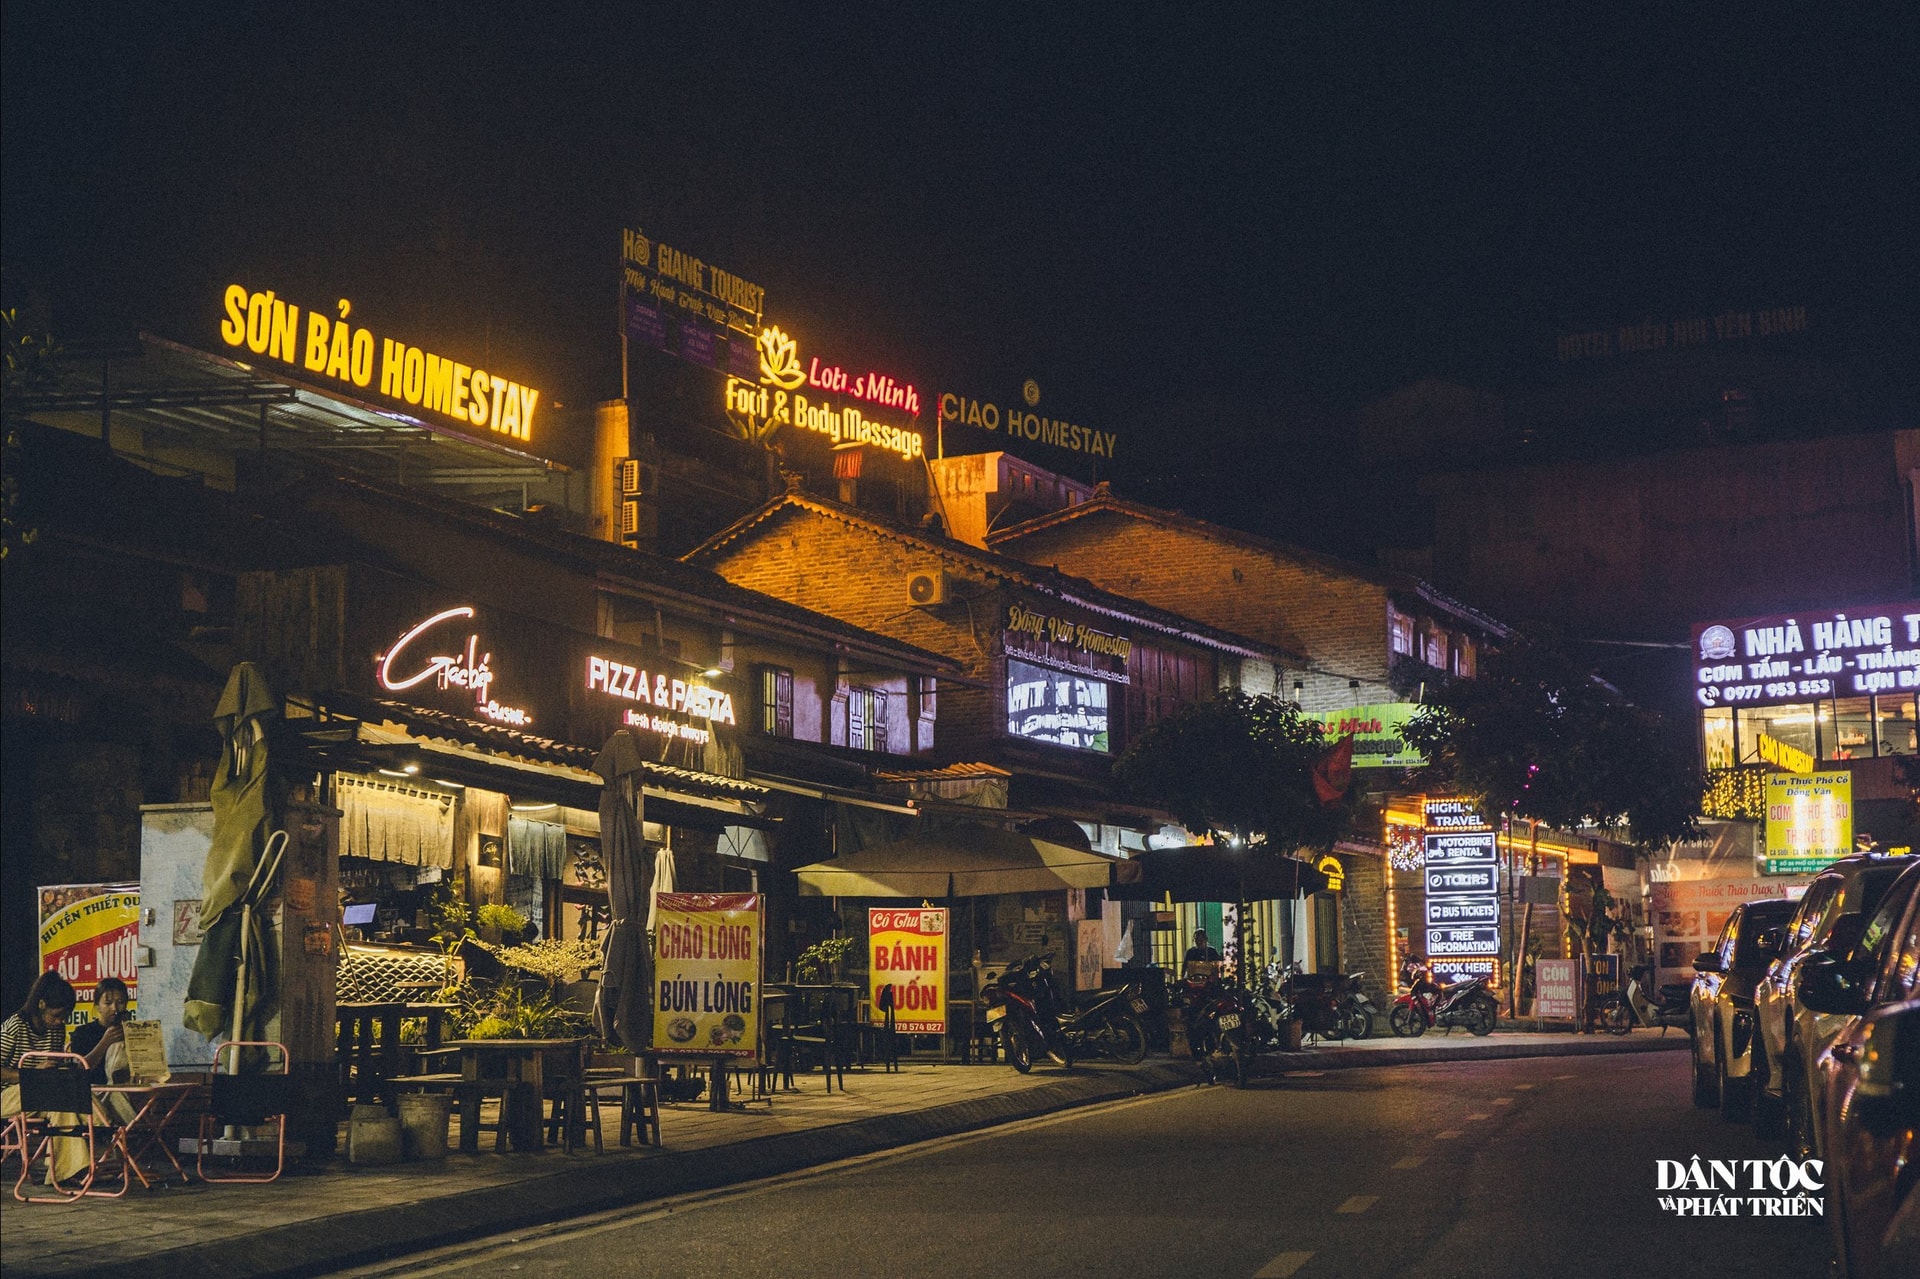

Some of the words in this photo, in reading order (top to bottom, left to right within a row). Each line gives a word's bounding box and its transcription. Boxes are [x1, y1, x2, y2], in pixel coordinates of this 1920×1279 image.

[658, 243, 702, 289] GIANG
[710, 265, 765, 314] TOURIST
[221, 284, 299, 364] SƠN
[304, 299, 375, 387] BẢO
[380, 337, 539, 442] HOMESTAY
[866, 372, 921, 413] Minh
[794, 394, 840, 443] Body
[842, 407, 922, 461] Massage
[942, 393, 1000, 431] CIAO
[1008, 409, 1117, 459] HOMESTAY
[1076, 624, 1132, 665] Homestay
[1744, 619, 1804, 657] NHÀ
[1812, 613, 1892, 651] HÀNG
[1698, 664, 1742, 683] CƠM
[1749, 655, 1790, 680] TẤM
[1804, 650, 1843, 675] LẨU
[589, 656, 651, 703] PIZZA
[654, 674, 669, 708] &
[671, 678, 736, 726] PASTA
[1723, 685, 1763, 701] 0977
[1765, 682, 1797, 698] 953
[1799, 679, 1830, 695] 553
[1854, 672, 1895, 693] LỢN
[627, 708, 649, 729] fresh
[651, 715, 678, 738] dough
[1353, 738, 1403, 758] assage
[1790, 776, 1812, 789] Thực
[1816, 774, 1834, 785] Phố
[1434, 815, 1484, 827] TRAVEL
[1770, 804, 1791, 820] CƠM
[1437, 836, 1492, 848] MOTORBIKE
[1784, 827, 1817, 844] THNG
[1447, 847, 1483, 858] RENTAL
[1443, 873, 1489, 886] TOURS
[1751, 881, 1774, 899] Dược
[41, 911, 81, 944] HUYỀN
[83, 895, 120, 916] THIẾT
[871, 912, 890, 928] Cô
[893, 912, 920, 928] Thu
[1442, 906, 1460, 917] BUS
[1460, 905, 1494, 917] TICKETS
[659, 917, 703, 960] CHÁO
[708, 917, 751, 961] LÒNG
[1450, 931, 1475, 941] FREE
[875, 940, 937, 971] BÁNH
[1431, 941, 1495, 953] INFORMATION
[48, 950, 79, 980] ẨU
[1433, 962, 1464, 973] BOOK
[1465, 962, 1493, 973] HERE
[1542, 963, 1569, 982] CÒN
[76, 989, 95, 1001] POT
[660, 973, 698, 1013] BÚN
[703, 973, 751, 1014] LÒNG
[1540, 982, 1573, 1000] PHÒNG
[909, 1023, 924, 1032] 574
[926, 1023, 942, 1032] 027
